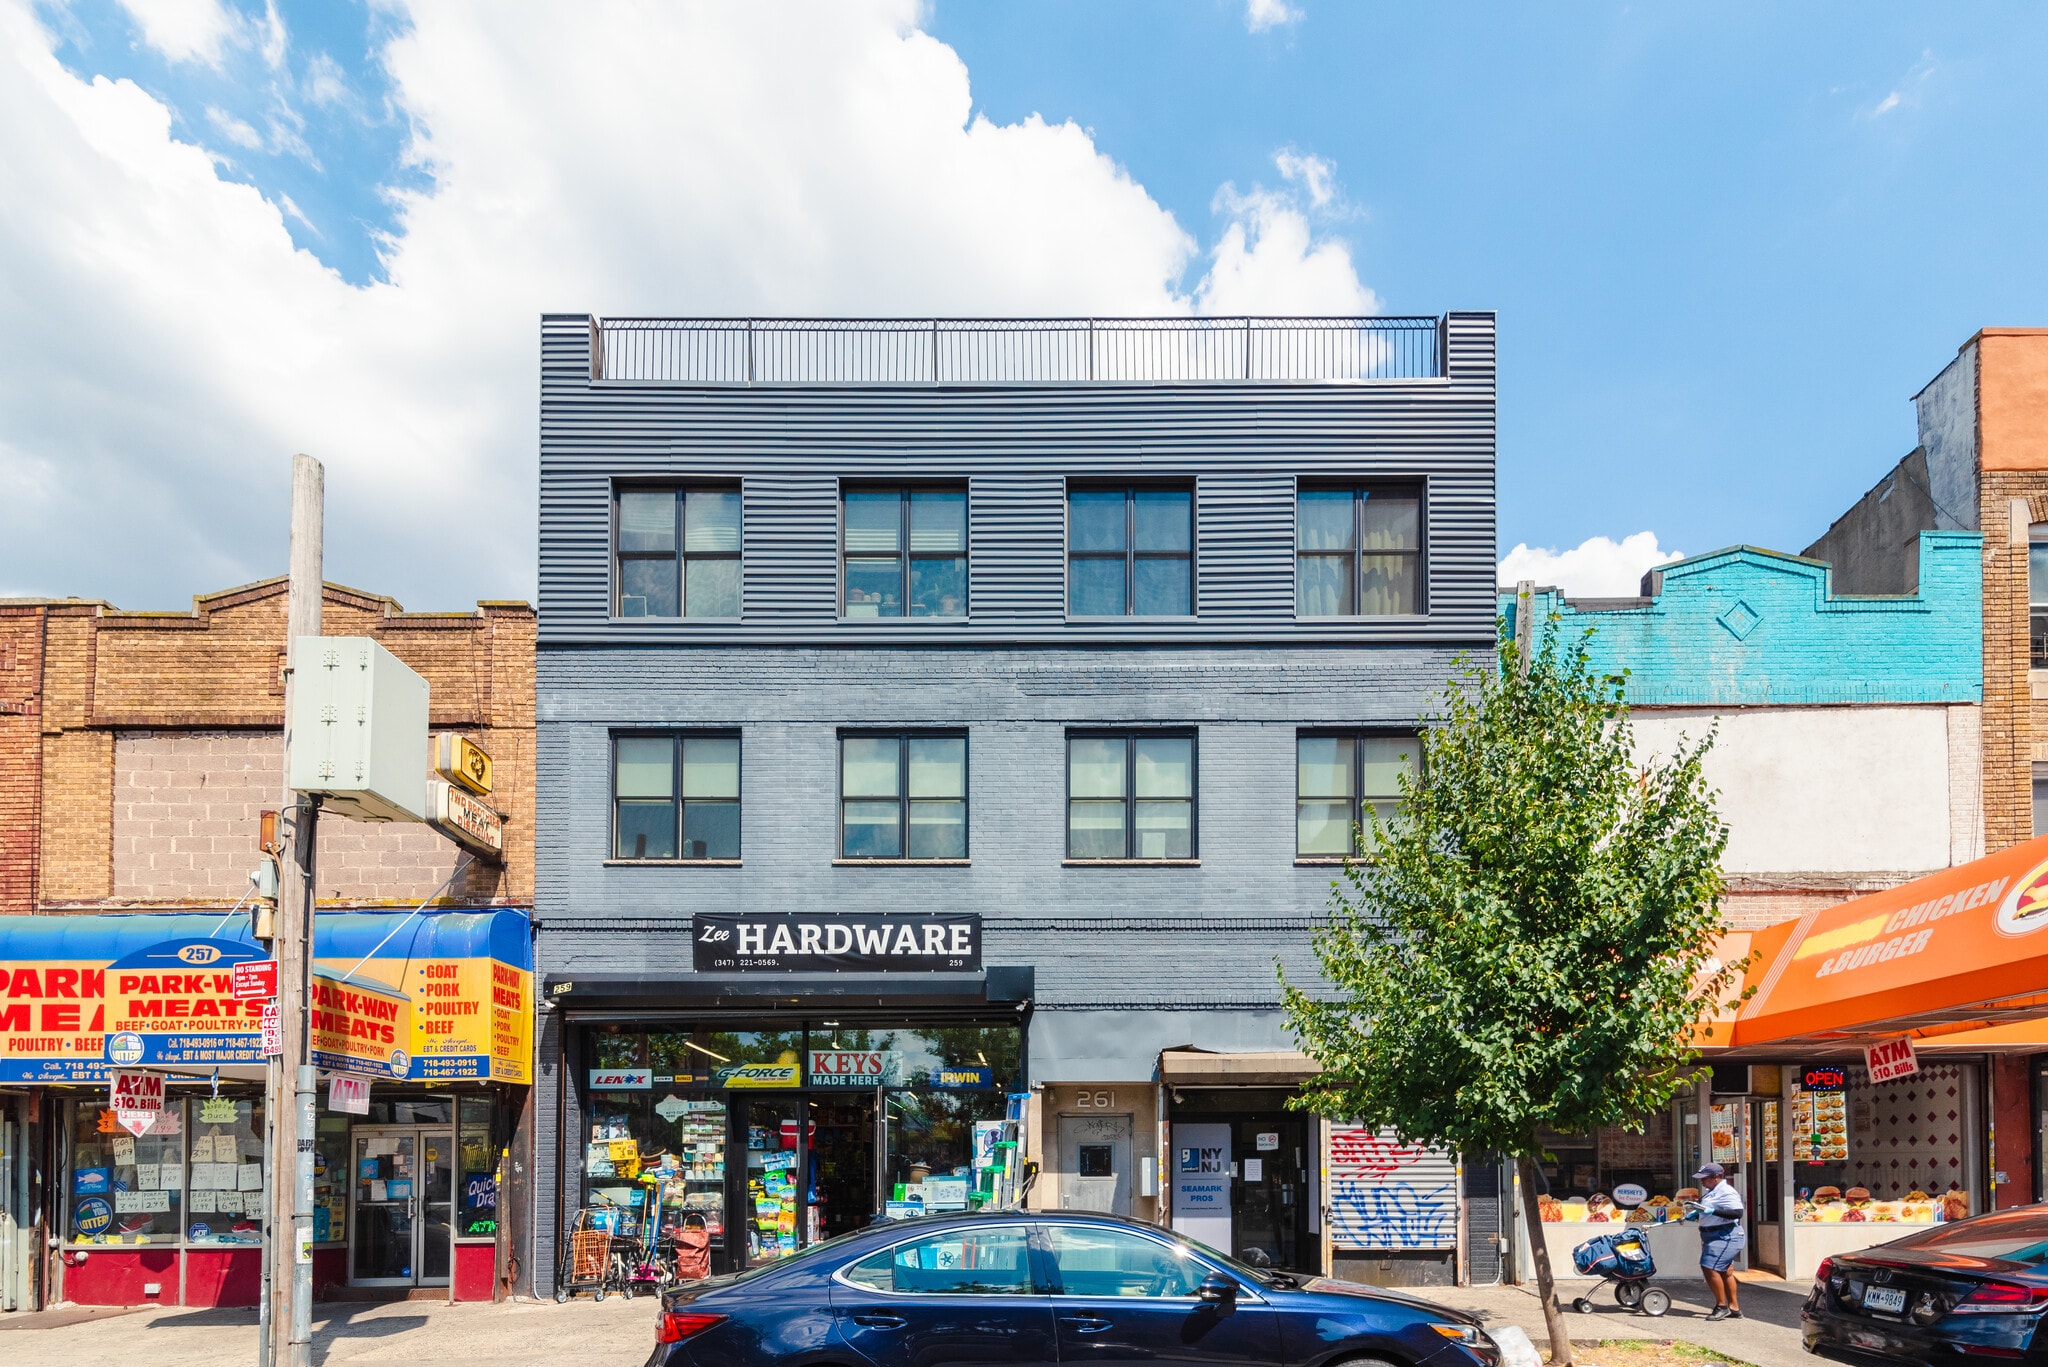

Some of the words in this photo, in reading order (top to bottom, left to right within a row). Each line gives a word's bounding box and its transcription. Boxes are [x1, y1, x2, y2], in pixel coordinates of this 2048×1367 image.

[1884, 875, 2010, 934] CHICKEN
[699, 925, 730, 943] Zee
[736, 924, 972, 955] HARDWARE
[185, 948, 213, 961] 257
[236, 966, 244, 974] NO
[245, 964, 272, 973] STANDING
[714, 959, 735, 967] (347)
[949, 959, 963, 967] 259
[426, 965, 458, 979] GOAT
[426, 983, 460, 997] PORK
[555, 983, 571, 994] 259
[493, 986, 520, 1010] MEATS
[128, 999, 269, 1018] MEATS
[426, 1001, 479, 1015] POULTRY
[496, 1009, 510, 1020] GOAT
[116, 1021, 145, 1031] BEEF
[151, 1020, 183, 1030] GOAT
[189, 1020, 242, 1030] POULTRY
[312, 1009, 395, 1044] MEATS
[425, 1021, 454, 1034] BEEF
[496, 1021, 511, 1032] PORK
[9, 1038, 64, 1051] POULTRY
[75, 1038, 104, 1051] BEEF
[496, 1033, 519, 1046] POULTRY
[323, 1039, 339, 1049] GOAT
[341, 1041, 368, 1053] POULTRY
[370, 1045, 385, 1057] PORK
[496, 1045, 510, 1056] BEEF
[1869, 1039, 1912, 1069] ATM
[235, 1050, 254, 1060] CREDIT
[65, 1062, 84, 1070] 718
[423, 1059, 477, 1067] 718-493-0916
[813, 1053, 882, 1074] KEYS
[1894, 1062, 1914, 1077] Bills
[72, 1071, 91, 1079] EBT
[718, 1068, 794, 1078] G-FORCE
[940, 1072, 980, 1084] IRWIN
[1805, 1072, 1844, 1085] OPEN
[115, 1074, 162, 1097] ATM
[813, 1076, 846, 1086] MADE
[850, 1076, 879, 1086] HERE
[140, 1098, 162, 1110] Bills
[1077, 1091, 1115, 1108] 261
[1201, 1148, 1222, 1160] NY
[1201, 1162, 1221, 1173] NJ
